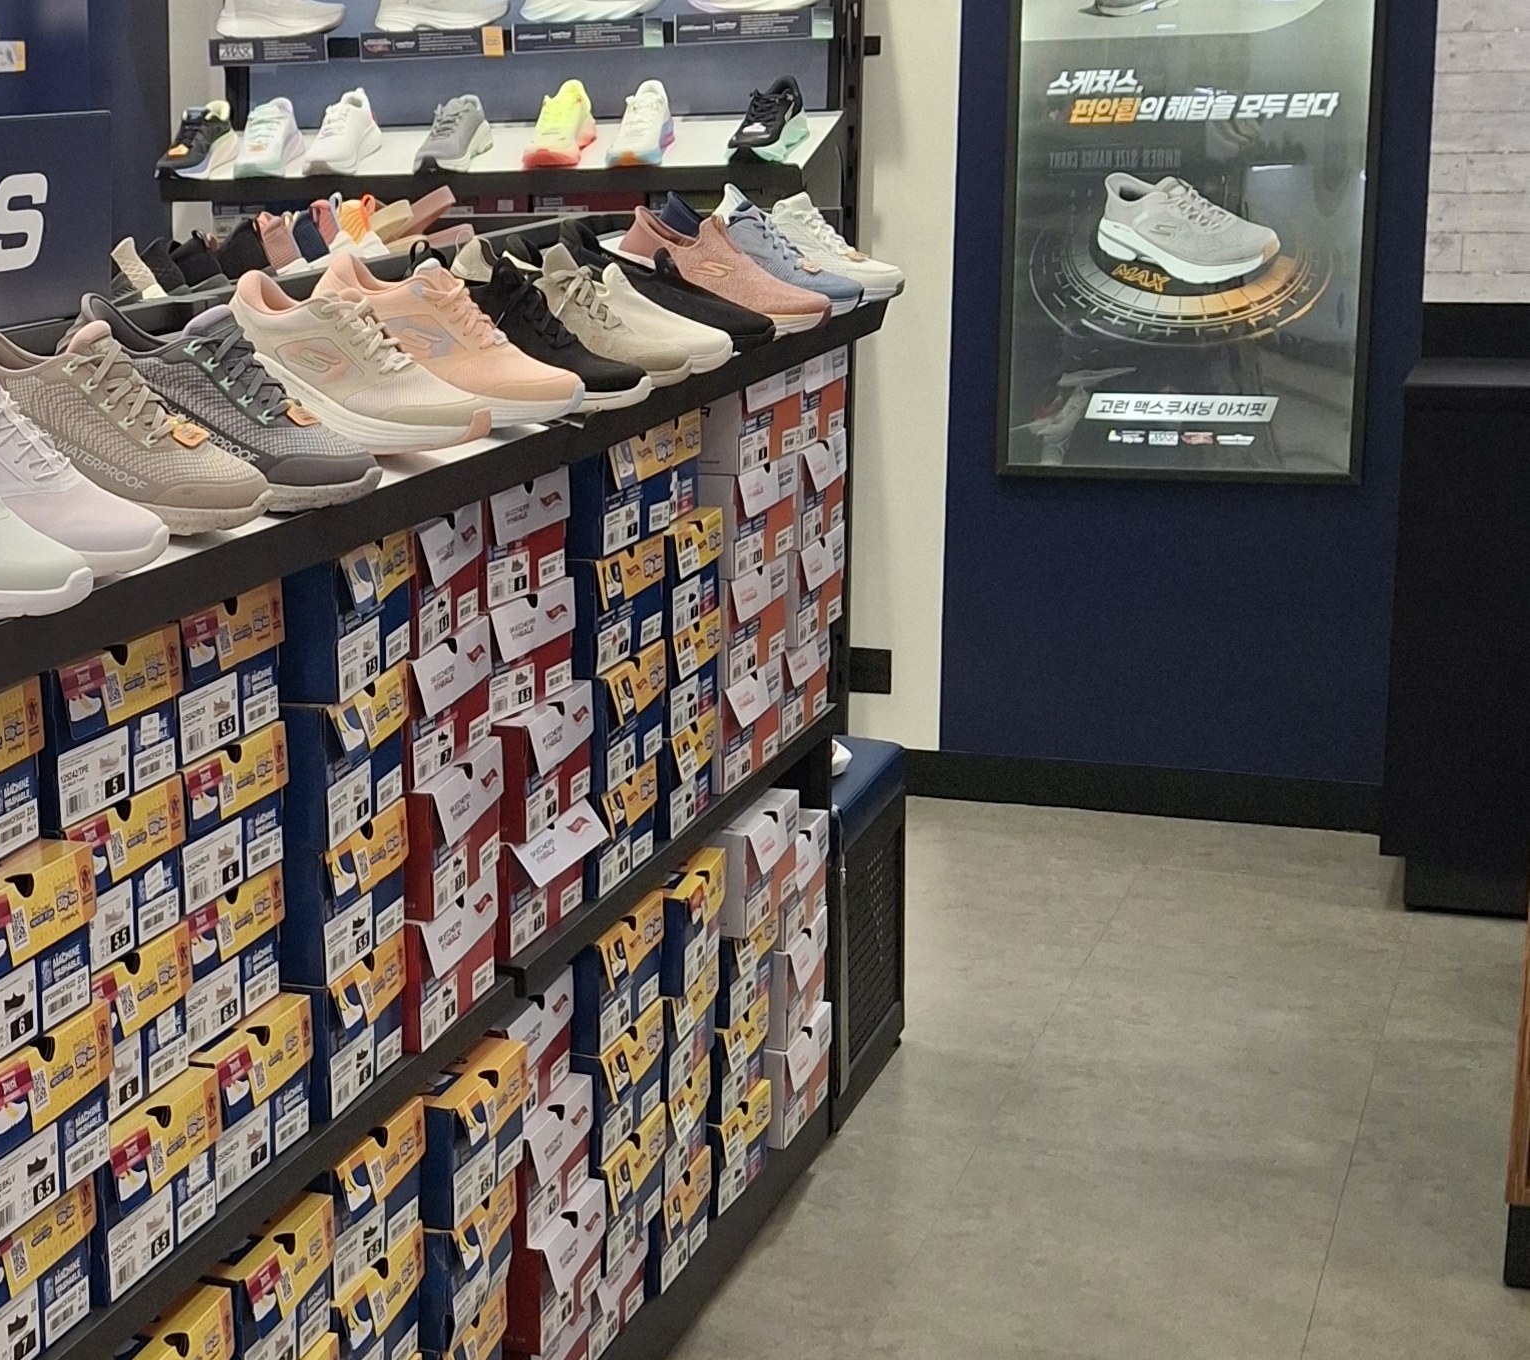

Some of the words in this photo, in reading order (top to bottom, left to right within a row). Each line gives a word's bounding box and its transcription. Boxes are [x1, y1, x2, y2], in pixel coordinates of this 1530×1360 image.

[1068, 96, 1167, 125] 편안함의
[1166, 93, 1236, 121] 해답을
[1236, 95, 1285, 120] 모두
[1286, 92, 1340, 119] 담다
[1112, 262, 1171, 293] MAX
[1096, 398, 1130, 415] 고런
[1216, 401, 1269, 418] 아치핏
[56, 438, 148, 492] WATERPROOF
[220, 719, 234, 736] 5.5
[111, 776, 120, 794] 5
[114, 928, 128, 949] 5.5
[52, 944, 81, 968] MACHINE
[18, 1017, 26, 1035] 6
[36, 1177, 53, 1201] 6.5
[153, 1235, 169, 1256] 6.5
